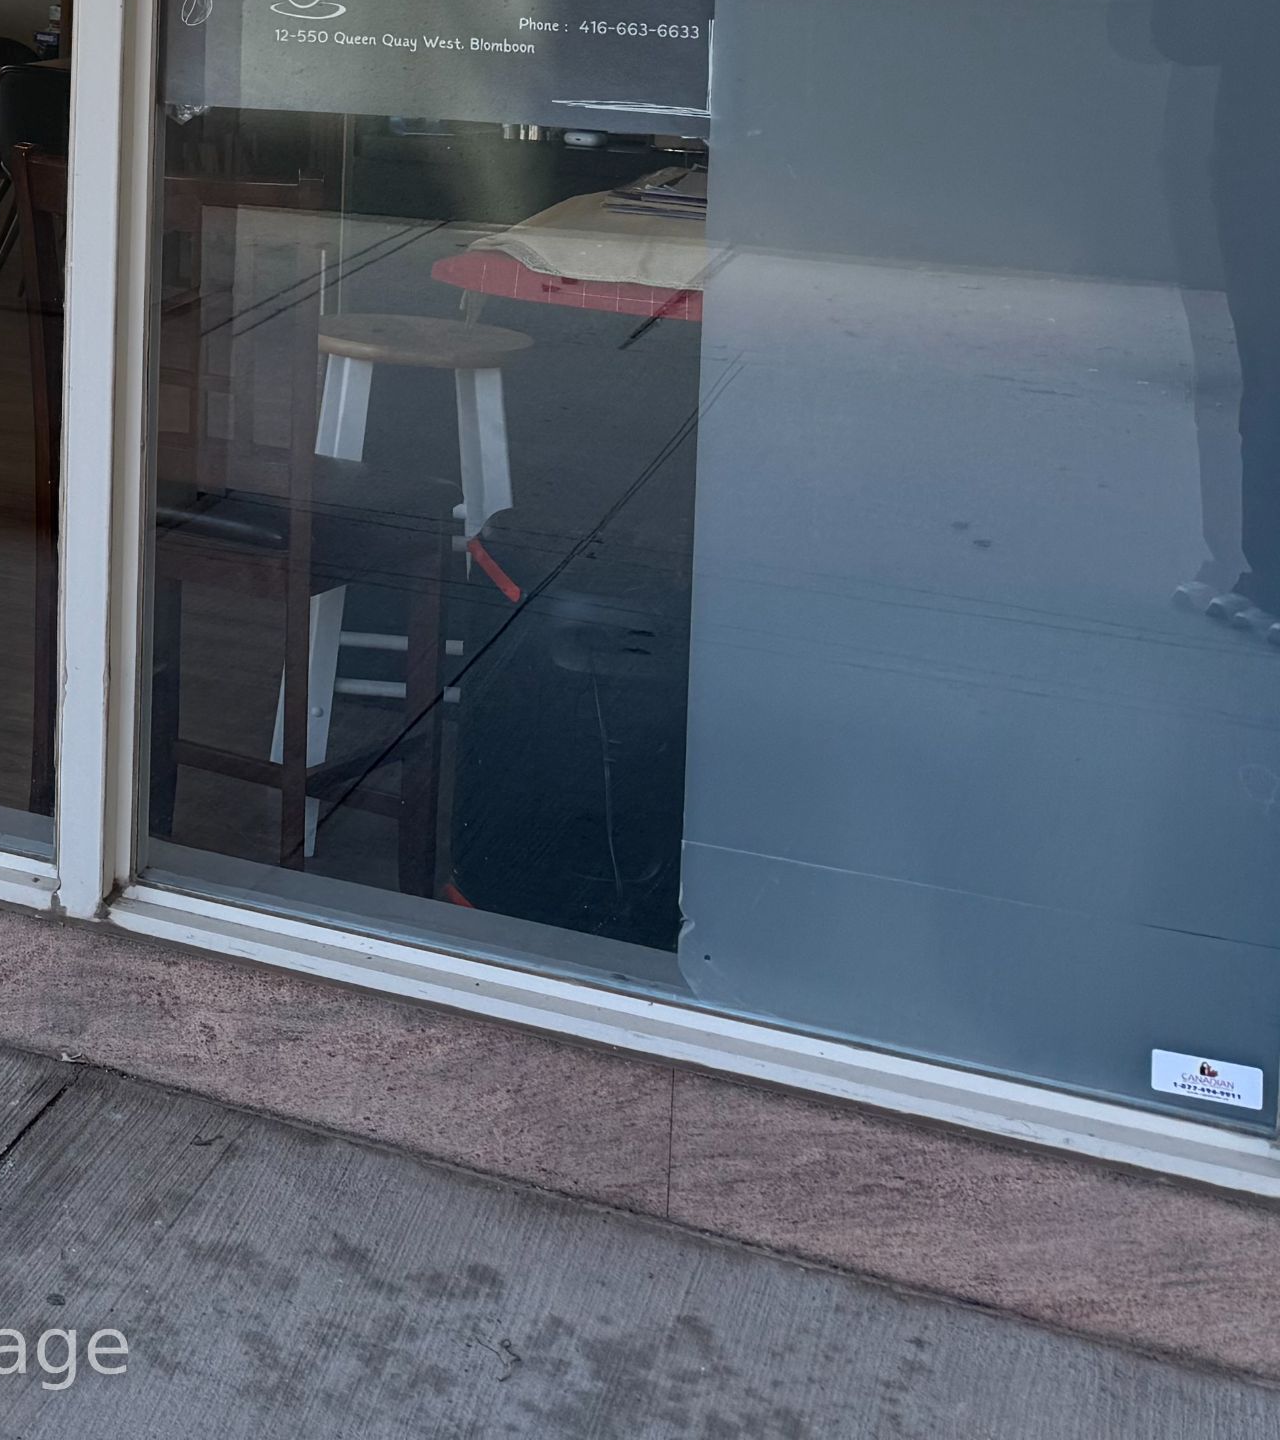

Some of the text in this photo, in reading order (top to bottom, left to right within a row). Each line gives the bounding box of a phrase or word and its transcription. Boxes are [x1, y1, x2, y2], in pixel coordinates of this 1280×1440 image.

[519, 17, 559, 33] Phone
[579, 20, 700, 39] 416-663-6633
[274, 28, 328, 44] 12-550
[334, 30, 376, 47] Queen
[383, 32, 417, 52] Quay
[470, 37, 535, 55] Blomboon
[1181, 1071, 1235, 1090] CANADIAN
